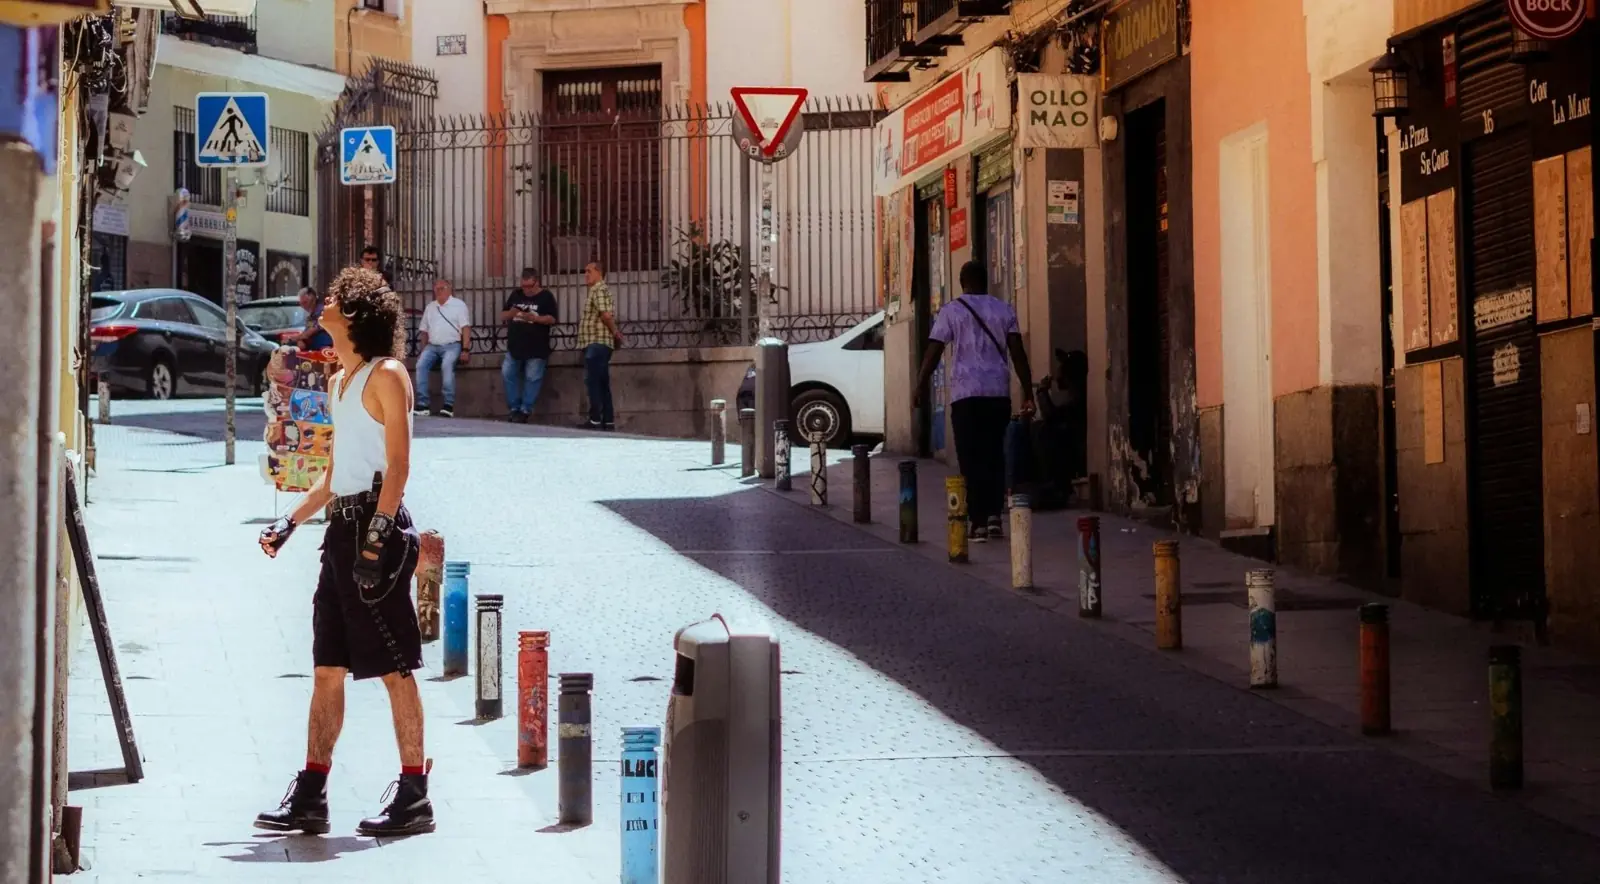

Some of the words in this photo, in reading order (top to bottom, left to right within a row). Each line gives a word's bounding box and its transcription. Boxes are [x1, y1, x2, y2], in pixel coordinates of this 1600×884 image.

[1526, 0, 1573, 11] BOCK
[1030, 89, 1088, 106] OLLO
[1030, 109, 1089, 127] MAO
[1482, 109, 1494, 135] 16
[621, 759, 658, 777] LAC
